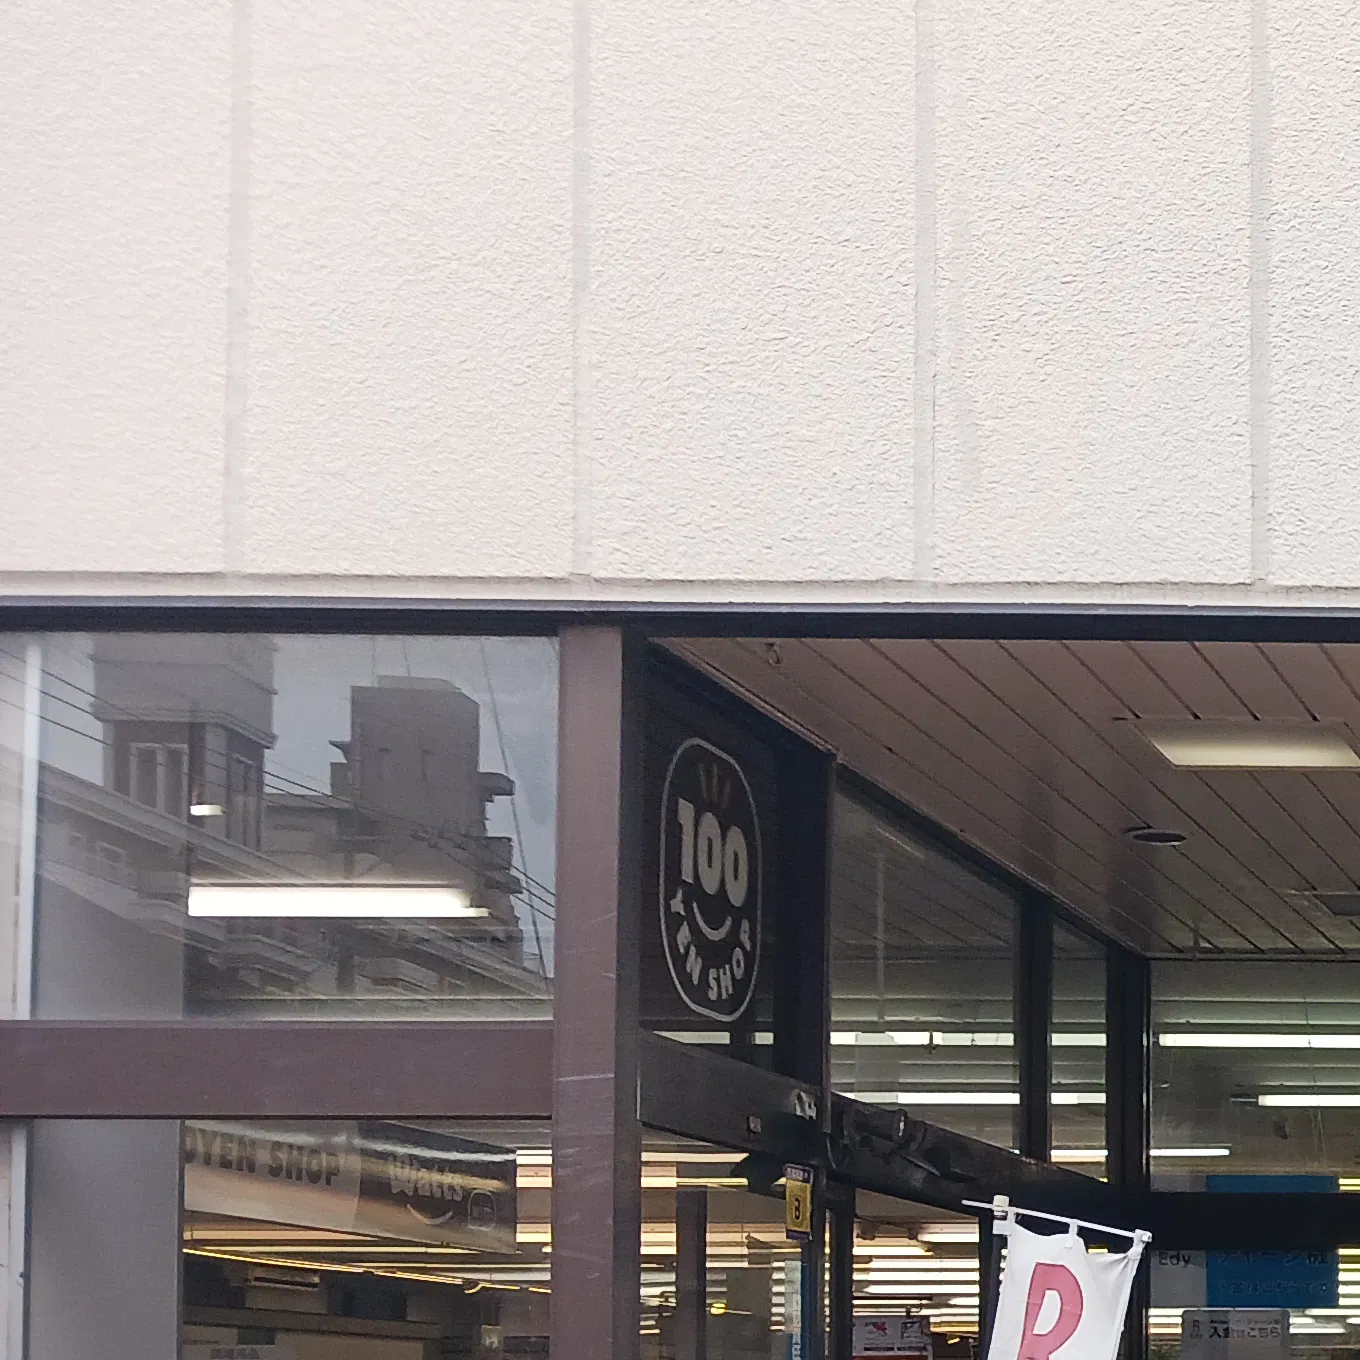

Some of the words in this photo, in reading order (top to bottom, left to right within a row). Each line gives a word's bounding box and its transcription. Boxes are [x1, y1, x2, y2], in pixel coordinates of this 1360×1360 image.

[676, 795, 750, 907] 100
[670, 885, 702, 987] YEN
[708, 922, 752, 1001] SHOP
[268, 1140, 340, 1186] SHOP
[387, 1153, 464, 1202] Watts
